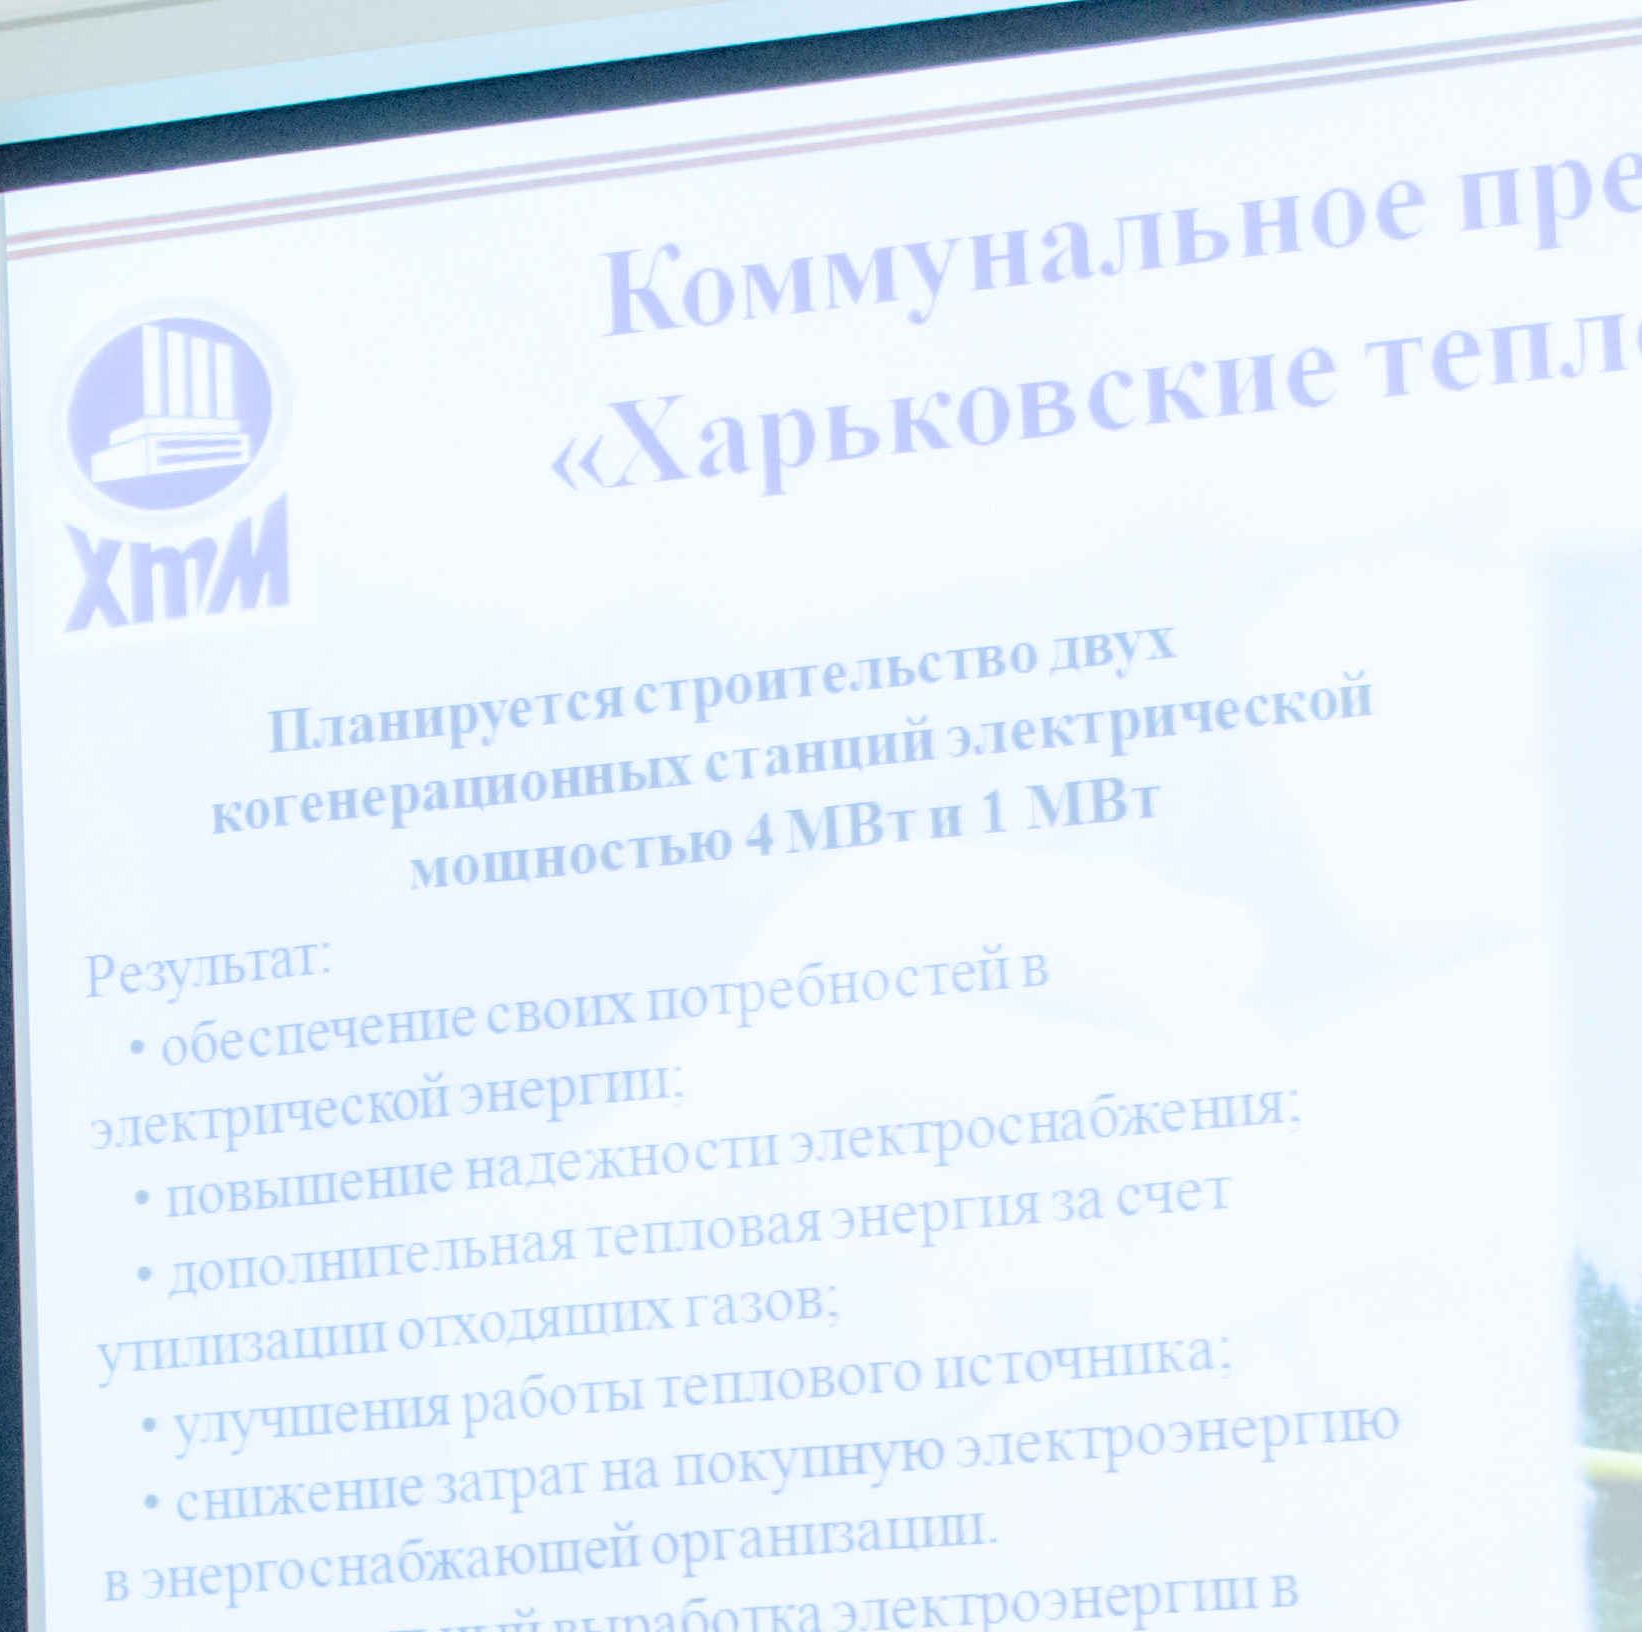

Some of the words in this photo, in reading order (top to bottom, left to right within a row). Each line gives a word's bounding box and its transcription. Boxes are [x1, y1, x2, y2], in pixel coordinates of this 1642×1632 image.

[601, 177, 1428, 338] Коммунальное
[266, 683, 627, 756] Планируется
[631, 639, 1041, 727] строительство
[1047, 624, 1179, 681] двух
[209, 751, 695, 837] когенерационных
[702, 712, 938, 786] станций
[945, 667, 1375, 760] электрической
[408, 826, 736, 892] мощностью
[742, 809, 778, 859] 4
[782, 798, 920, 856] МВт
[926, 802, 966, 842] и
[981, 786, 1008, 836] 1
[1024, 774, 1163, 832] МВт
[159, 1003, 479, 1068] обеспечение
[483, 989, 639, 1037] своих
[645, 941, 1012, 1031] потребностей
[1019, 951, 1052, 990] в
[89, 1069, 452, 1155] электрической
[165, 1158, 457, 1220] повышение
[463, 1131, 781, 1193] надежности
[166, 1225, 578, 1300] дополнительная
[585, 1207, 824, 1260] тепловая
[830, 1189, 1042, 1250] энергия
[1050, 1184, 1106, 1224] за
[1114, 1174, 1233, 1219] счет
[94, 1318, 390, 1391] утилизации
[395, 1295, 676, 1353] отходящих
[171, 1391, 453, 1463] улучшения
[459, 1370, 647, 1442] работы
[654, 1357, 925, 1411] теплового
[173, 1472, 427, 1525] снижение
[433, 1459, 590, 1517] затрат
[599, 1454, 662, 1495] на
[672, 1435, 949, 1498] покупную
[954, 1404, 1403, 1476] электроэнергию
[102, 1567, 133, 1604] в
[140, 1518, 643, 1612] энергоснабжающей
[1269, 1571, 1302, 1611] в
